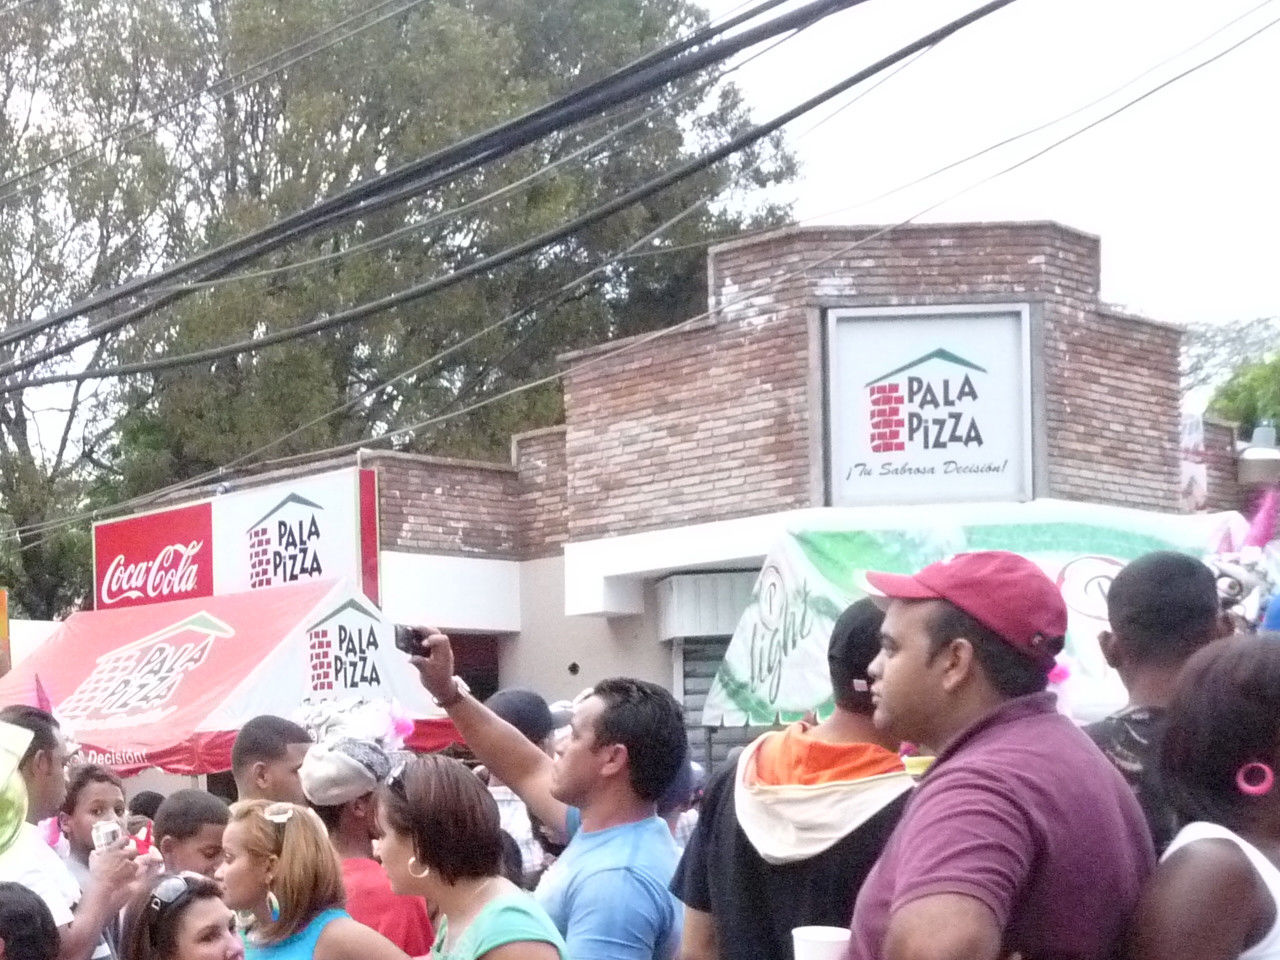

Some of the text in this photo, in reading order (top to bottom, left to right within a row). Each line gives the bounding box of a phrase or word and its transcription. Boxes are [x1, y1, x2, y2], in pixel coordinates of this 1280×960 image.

[907, 373, 979, 410] PALA
[878, 462, 935, 477] Sabrosa
[942, 459, 1009, 476] Decisión!
[277, 513, 321, 551] PALA
[101, 539, 204, 604] Coca-Cola
[135, 636, 215, 679] PALA
[338, 623, 379, 658] PALA
[750, 577, 814, 705] light
